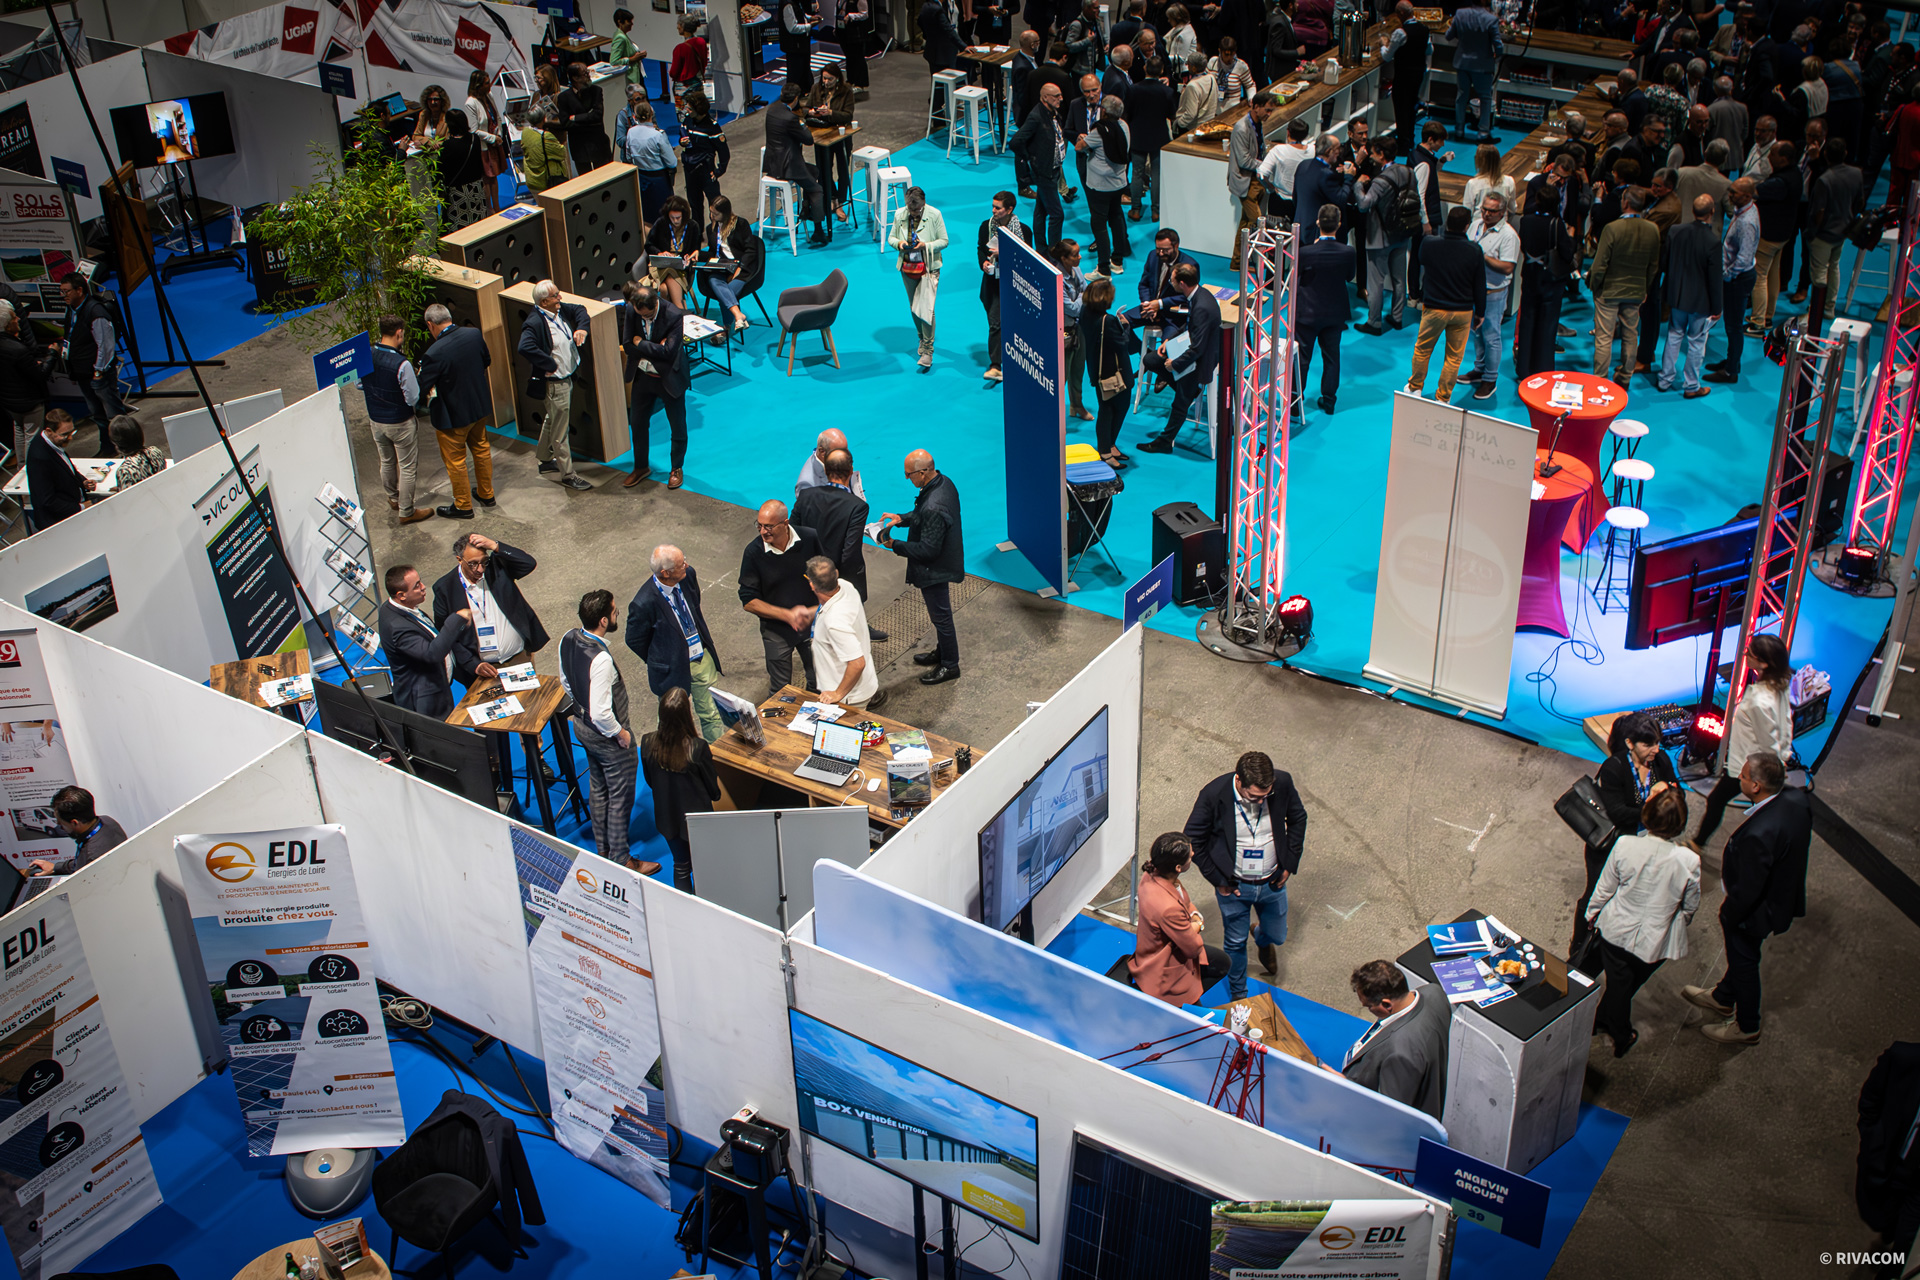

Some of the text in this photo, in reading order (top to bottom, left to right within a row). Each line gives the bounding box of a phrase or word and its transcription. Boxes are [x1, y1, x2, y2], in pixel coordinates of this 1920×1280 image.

[285, 21, 314, 40] UGAP
[457, 37, 486, 51] UGAP
[0, 125, 29, 149] REAU
[13, 193, 60, 207] SOLS
[17, 207, 64, 217] SPORTIFS
[1012, 269, 1041, 300] TERRITOIRES
[1012, 279, 1032, 302] D'ANJOU
[330, 348, 356, 365] NOTAIRES
[1013, 332, 1044, 371] ESPACE
[335, 357, 352, 369] ANJOU
[1005, 341, 1055, 397] CONVIVIALITÉ
[209, 463, 260, 519] VIC OUST
[228, 533, 269, 578] ENVIRONNEMENTAUX
[1136, 578, 1162, 604] VIC OUEST
[1144, 609, 1152, 620] 40
[0, 642, 17, 662] 9
[12, 686, 31, 694] étape
[268, 839, 326, 868] EDL
[267, 866, 326, 879] Energies de Loire
[224, 881, 319, 894] CONSTRUCTEUR, MAINTENEUR
[225, 891, 269, 899] PRODUCTEUR
[303, 885, 331, 893] SOLAIRE
[602, 880, 630, 904] EDL
[223, 909, 338, 926] produite chez vous.
[225, 902, 330, 916] Valorisez l'énergie produite
[533, 887, 560, 901] Réduisez
[559, 898, 575, 910] votre
[575, 906, 606, 924] empreinte
[606, 920, 631, 935] carbone
[534, 894, 557, 909] grâce
[557, 904, 568, 914] au
[568, 908, 629, 942] photovoltaïque
[3, 917, 55, 970] EDL
[292, 945, 311, 954] types
[573, 936, 598, 953] Energies
[598, 948, 608, 957] de
[607, 952, 623, 967] Loire,
[4, 943, 57, 982] Energies de Loire
[301, 981, 370, 991] Autoconsommation
[563, 972, 585, 986] proche
[1, 975, 75, 1026] mode de financement
[231, 991, 260, 999] Revente
[0, 991, 66, 1037] ous convient.
[16, 1009, 80, 1053] adaptées votre projet
[65, 1024, 89, 1043] Client
[592, 1019, 607, 1031] local
[55, 1022, 101, 1057] Investisseur
[234, 1041, 302, 1051] Autoconsommation
[314, 1035, 382, 1046] Autoconsommation
[332, 1041, 366, 1049] collective
[280, 1045, 306, 1054] surplus
[84, 1086, 108, 1105] Client
[334, 1083, 375, 1093] Candé (49)
[78, 1085, 118, 1116] Hébergeur
[599, 1084, 645, 1112] de son territoire
[317, 1105, 355, 1113] contactez
[813, 1096, 929, 1137] BOX VENDÉE LITTORAL
[620, 1121, 639, 1135] Candé
[631, 1115, 654, 1131] agences
[93, 1158, 129, 1186] Candé (49)
[1454, 1168, 1509, 1196] ANGEVIN
[1455, 1179, 1505, 1204] GROUPE
[38, 1228, 63, 1248] Lancez
[63, 1216, 82, 1231] vous,
[81, 1192, 114, 1218] contactez
[113, 1180, 130, 1195] nous
[39, 1191, 83, 1225] La Baule (44)
[1467, 1208, 1485, 1222] 39
[1364, 1226, 1407, 1244] EDL
[1360, 1242, 1383, 1250] Energies
